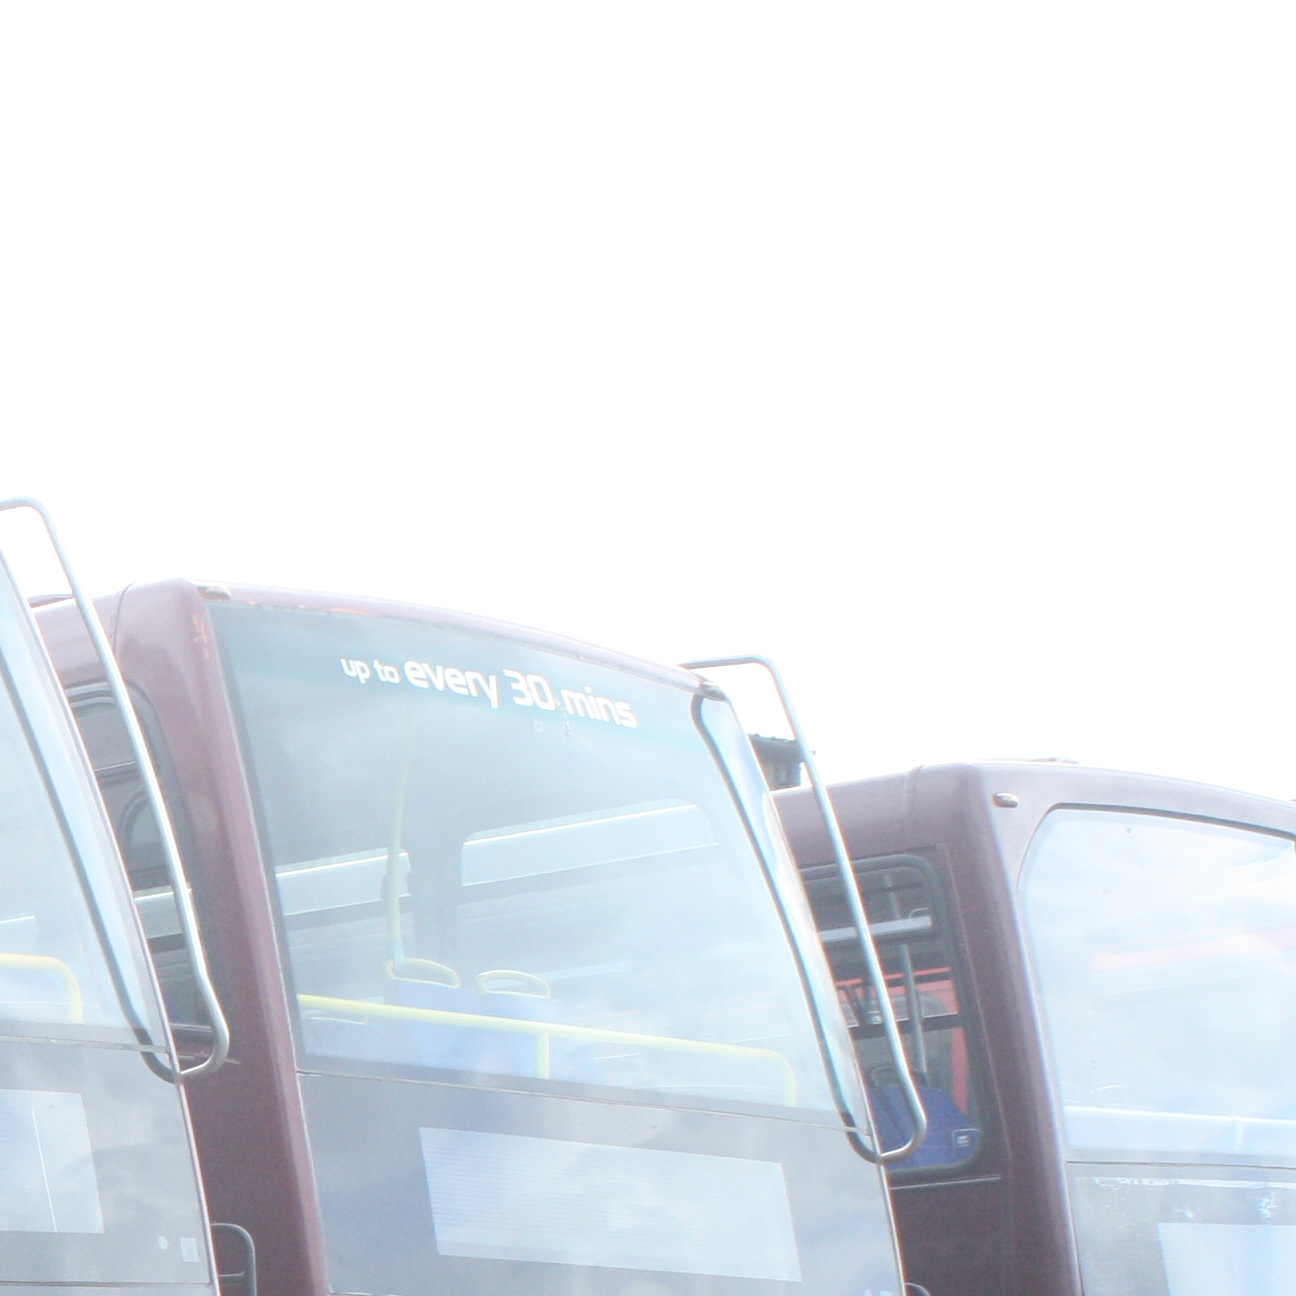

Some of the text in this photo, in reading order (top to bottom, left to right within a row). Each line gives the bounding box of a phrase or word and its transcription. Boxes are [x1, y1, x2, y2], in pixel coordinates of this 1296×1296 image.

[339, 657, 639, 729] up to every 30 mins
